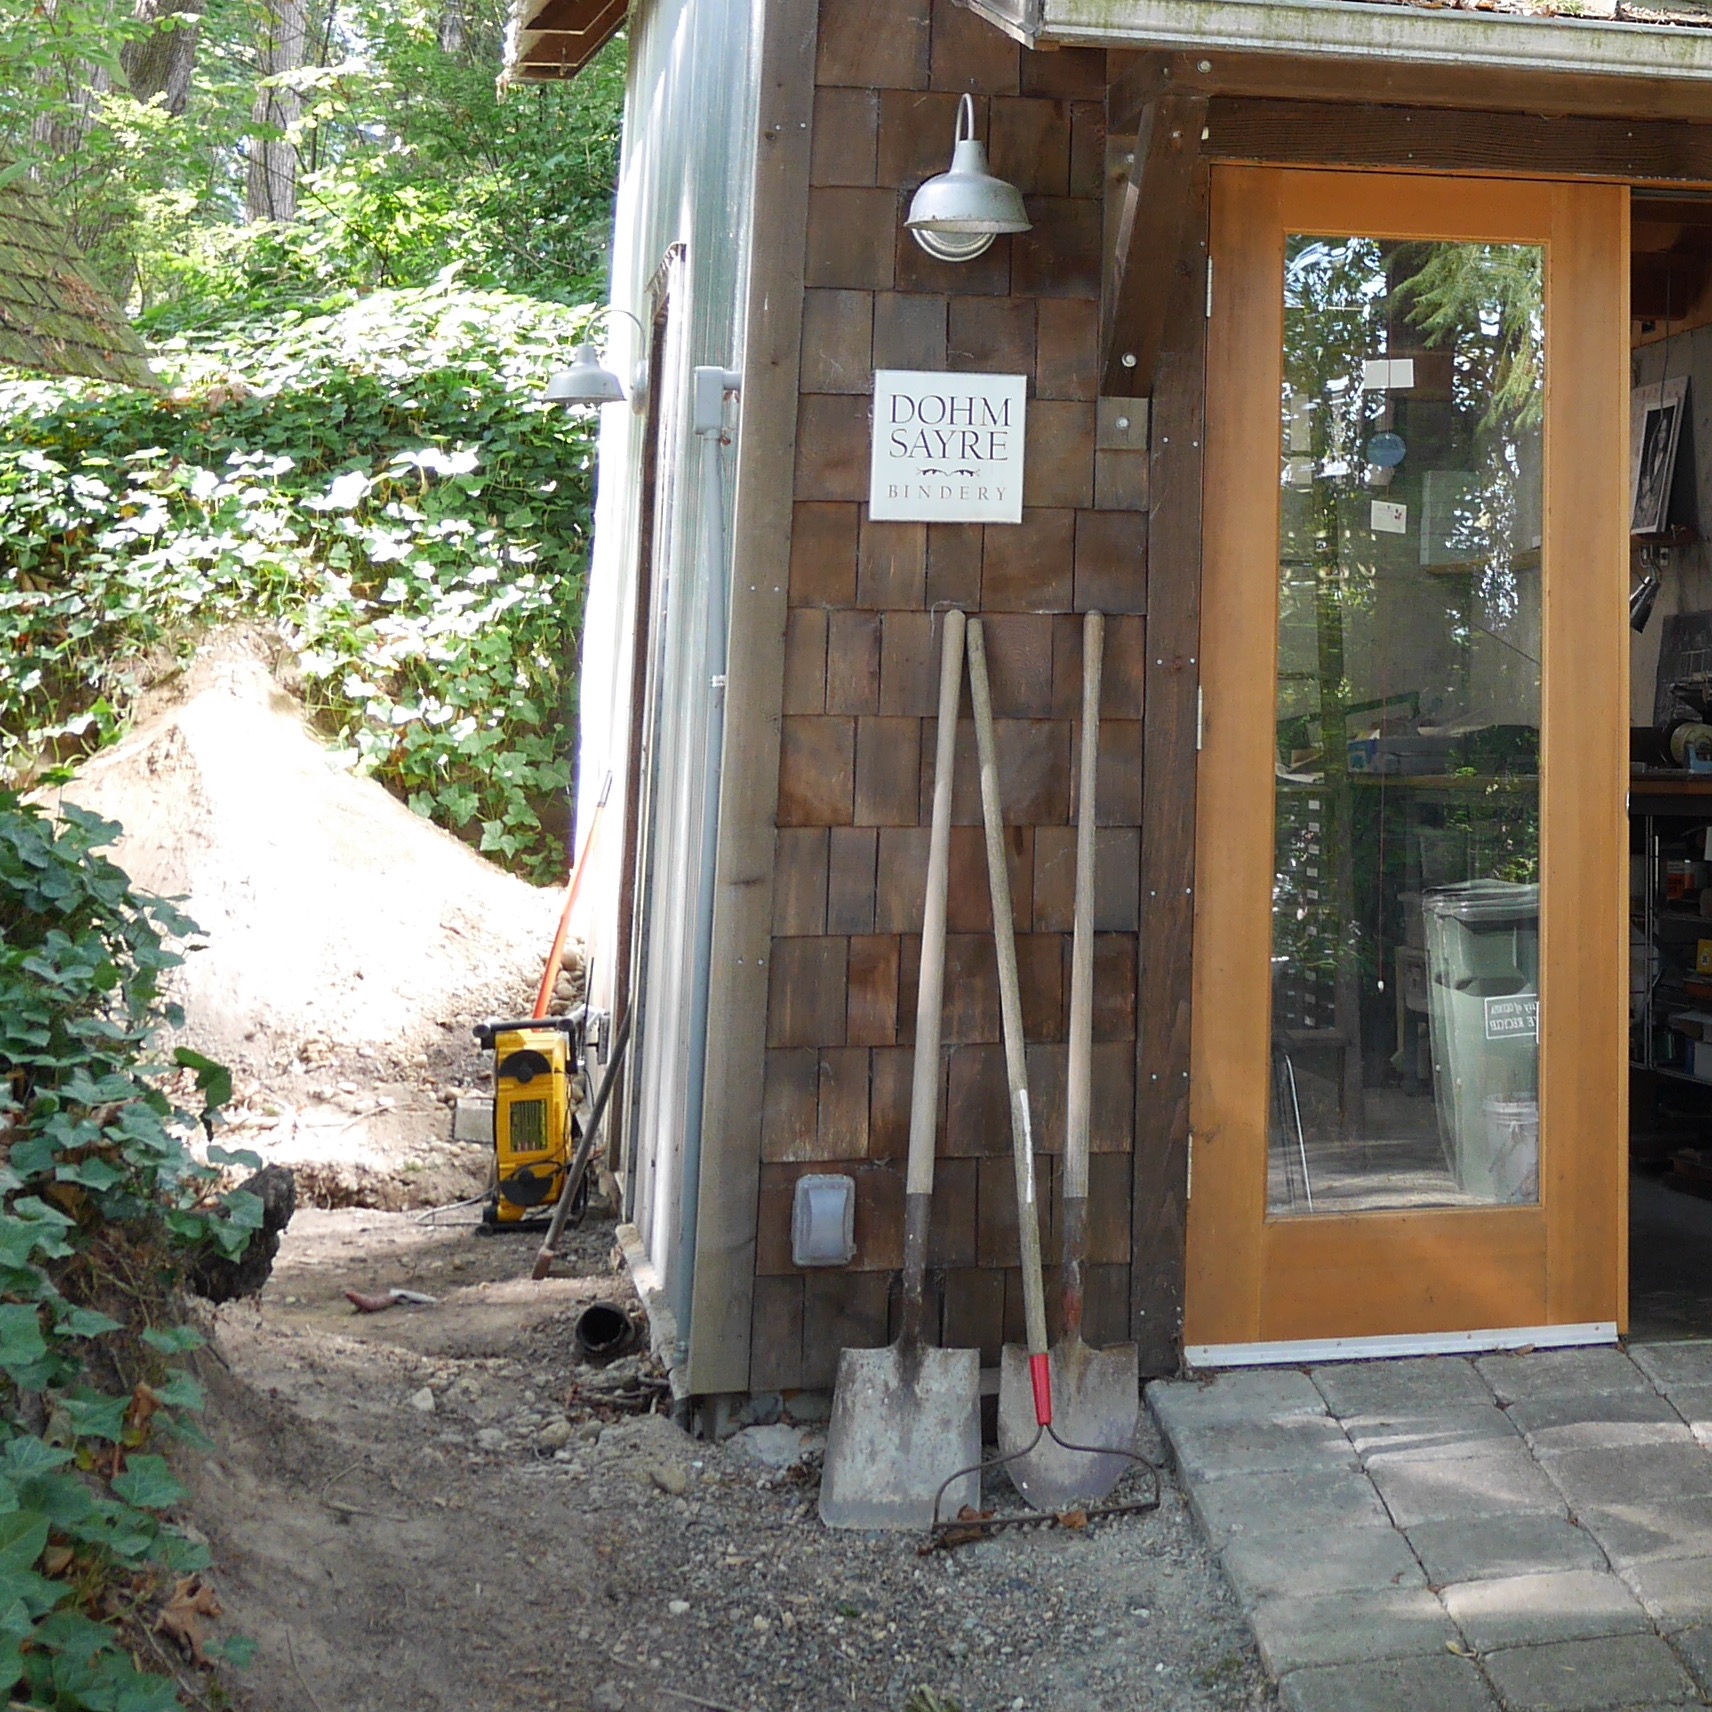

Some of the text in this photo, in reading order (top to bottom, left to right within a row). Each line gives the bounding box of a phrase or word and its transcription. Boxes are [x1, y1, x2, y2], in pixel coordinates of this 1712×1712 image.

[889, 394, 1012, 427] DOHM
[889, 428, 1008, 461] SAYRE
[888, 484, 1006, 501] BINDERY
